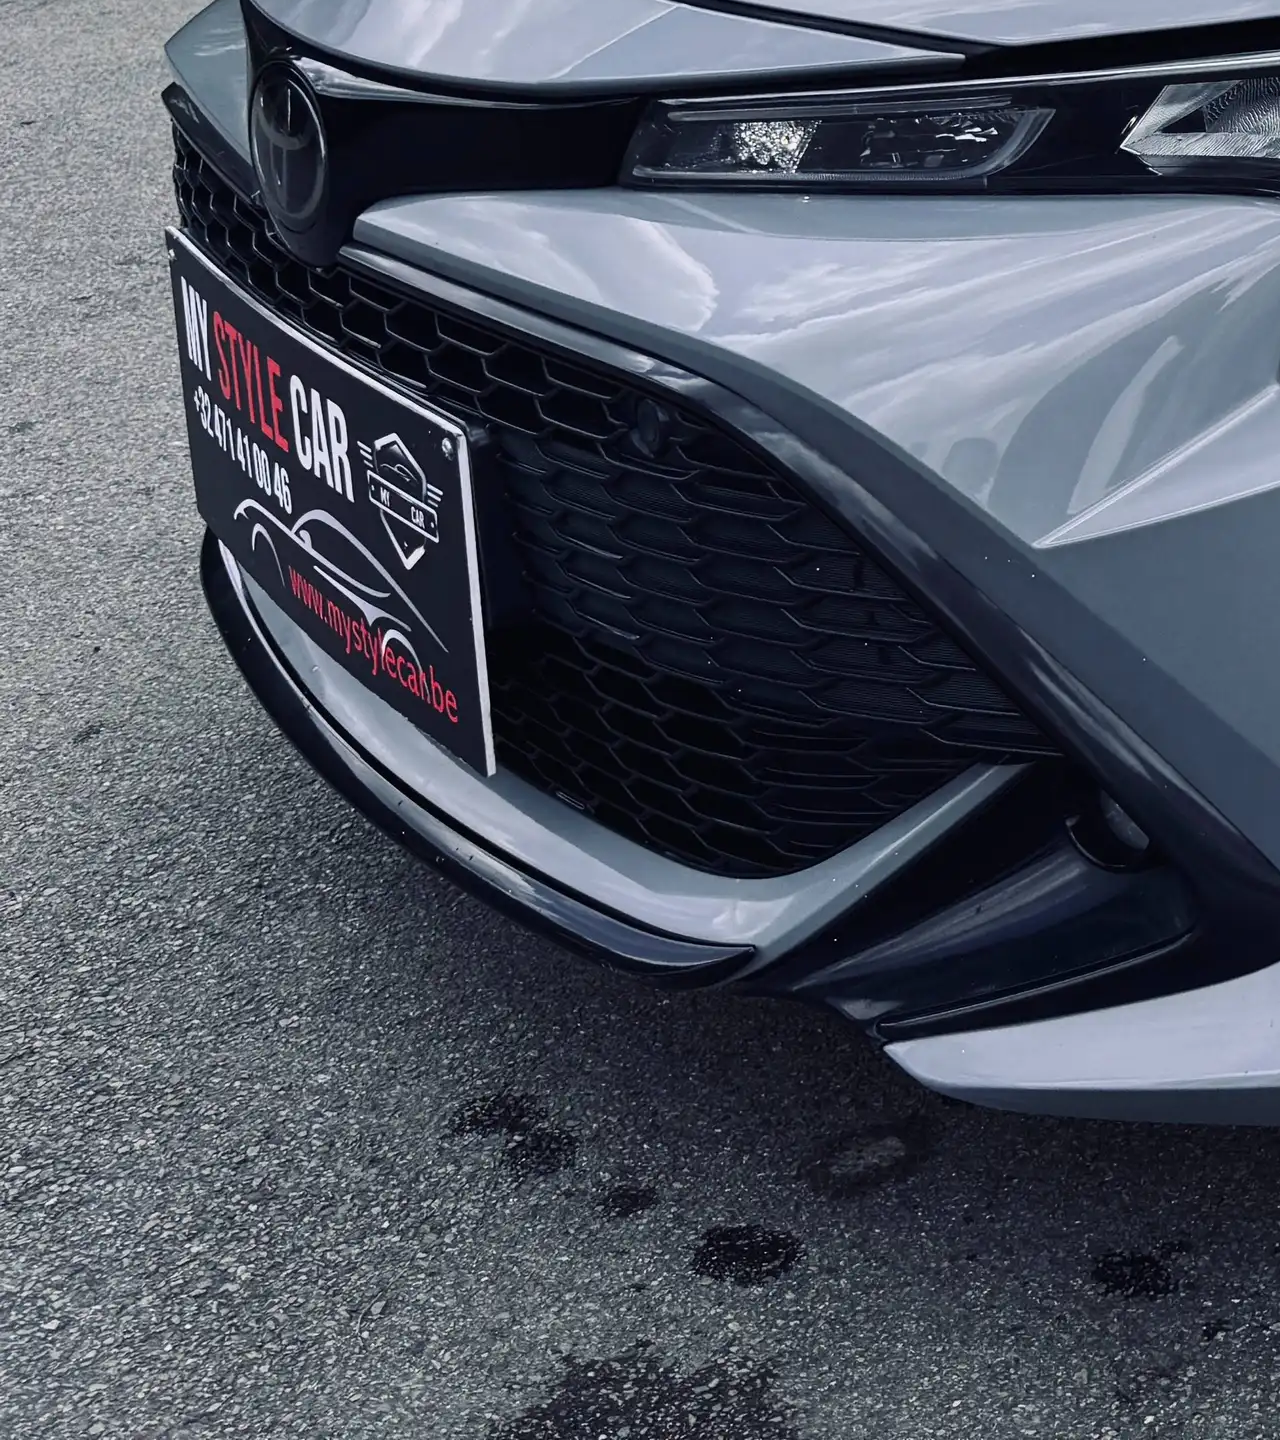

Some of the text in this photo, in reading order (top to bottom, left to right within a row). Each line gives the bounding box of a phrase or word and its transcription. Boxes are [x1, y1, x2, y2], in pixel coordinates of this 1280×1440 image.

[181, 275, 355, 504] MY STYLE CAR
[193, 385, 293, 515] +32 471 41 00 46
